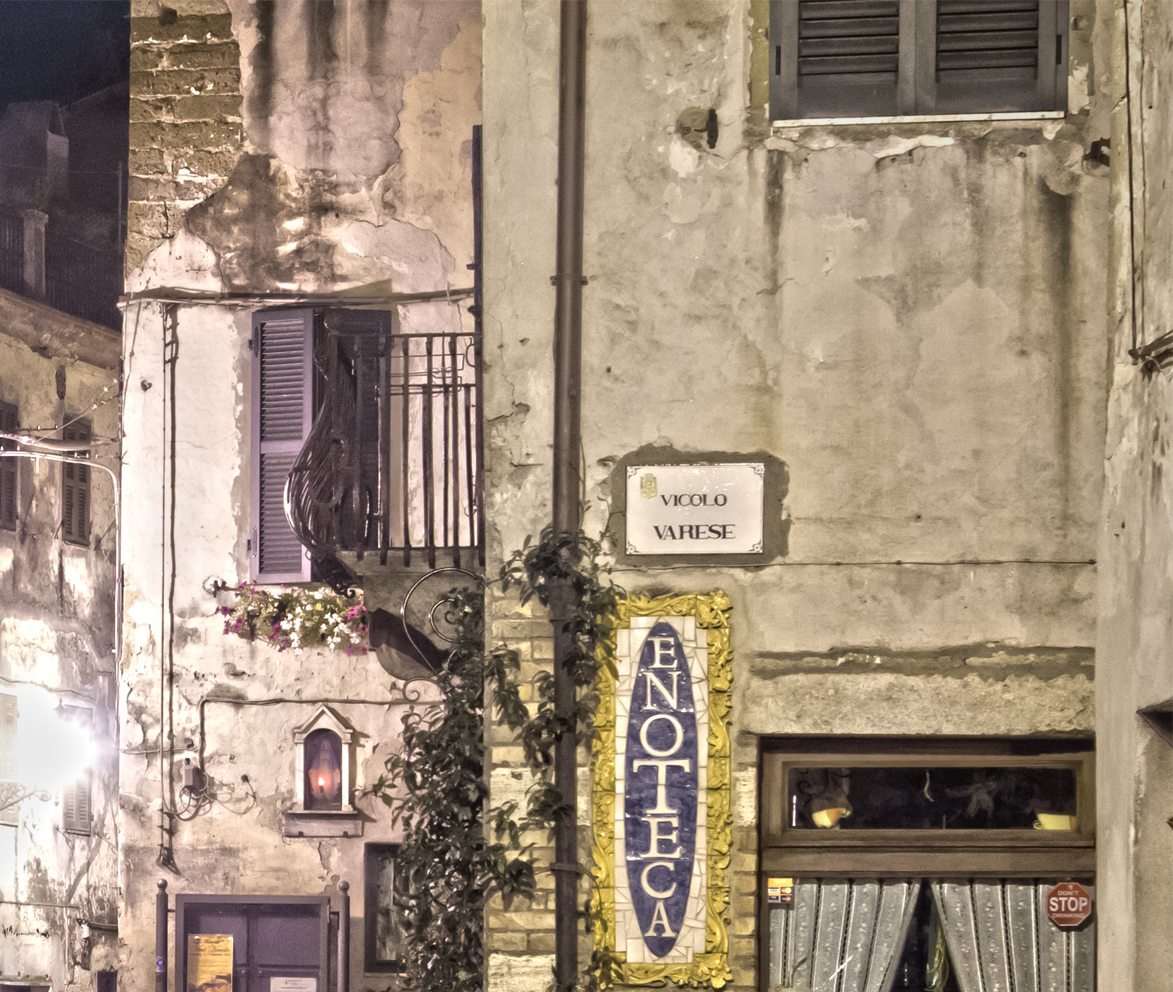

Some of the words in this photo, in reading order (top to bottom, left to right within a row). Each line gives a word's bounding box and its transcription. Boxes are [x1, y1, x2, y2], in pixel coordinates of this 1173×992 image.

[661, 494, 728, 507] VICOLO
[653, 524, 736, 540] VARESE
[633, 637, 690, 937] ENOTECA
[1049, 896, 1088, 912] STOP
